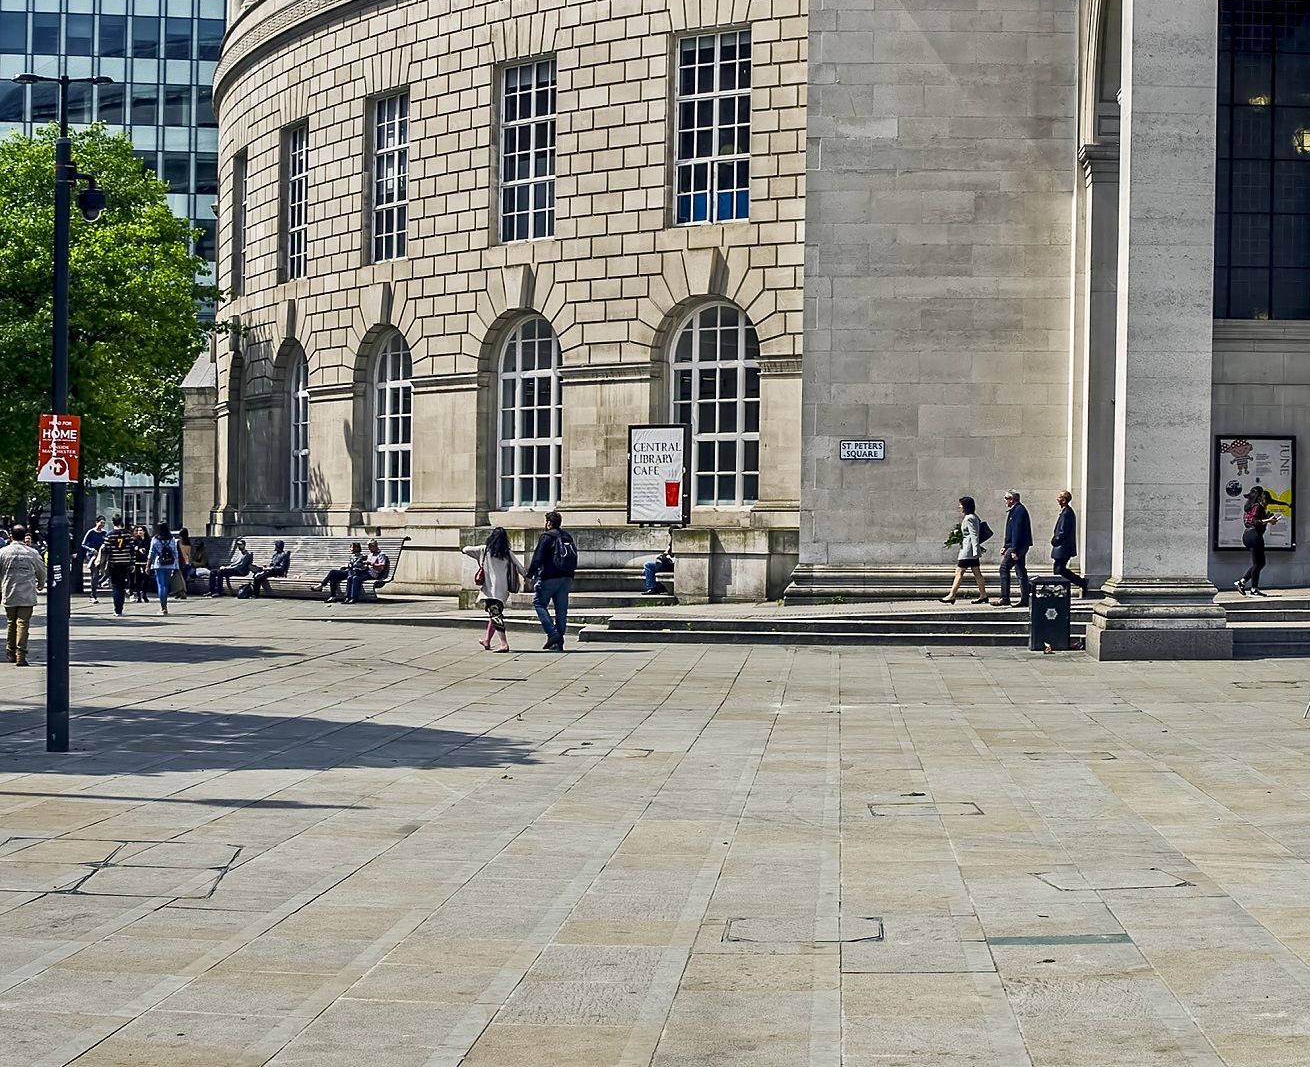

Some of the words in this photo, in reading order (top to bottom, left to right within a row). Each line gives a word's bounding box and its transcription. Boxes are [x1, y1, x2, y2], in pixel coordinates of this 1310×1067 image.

[42, 429, 77, 439] HOME
[633, 442, 682, 452] CENTRAL
[634, 454, 674, 464] LIBRARY
[846, 450, 878, 458] SQUARE
[1280, 445, 1290, 475] JUNE
[117, 538, 123, 548] 7
